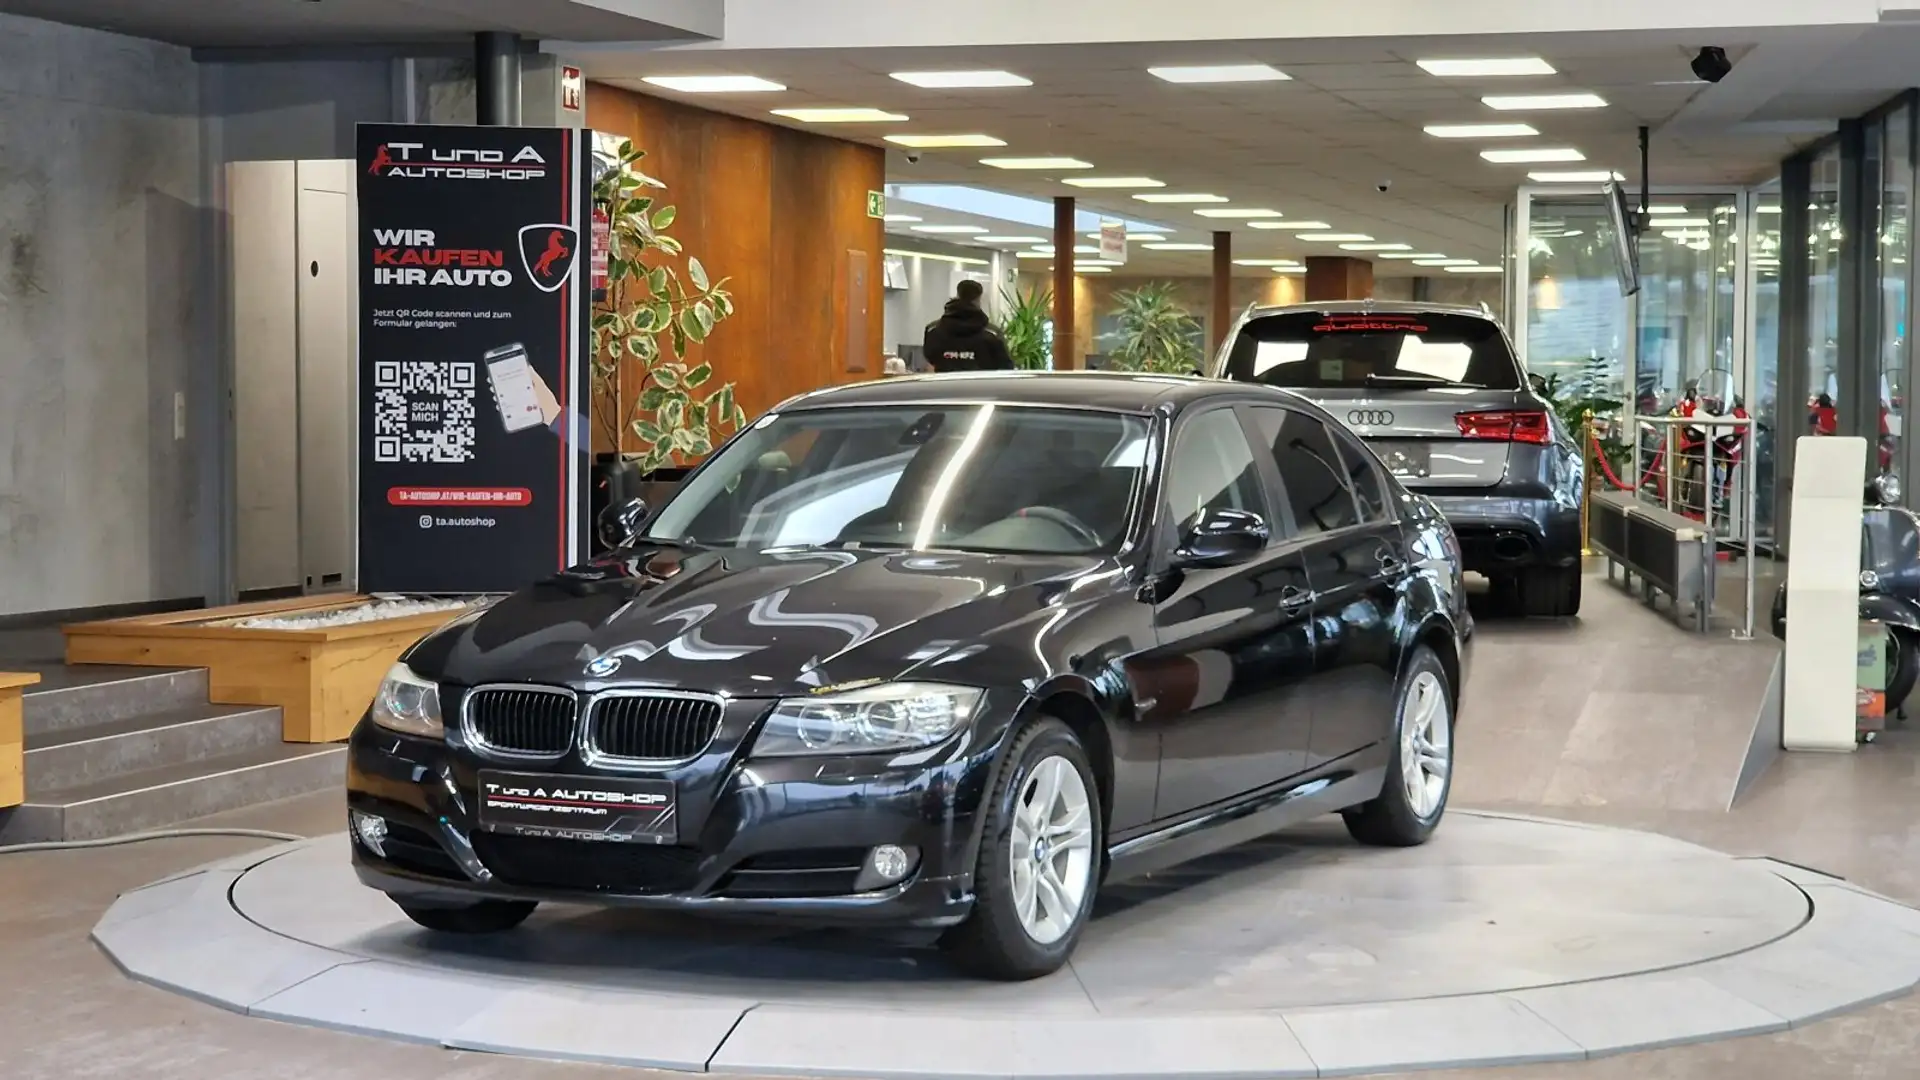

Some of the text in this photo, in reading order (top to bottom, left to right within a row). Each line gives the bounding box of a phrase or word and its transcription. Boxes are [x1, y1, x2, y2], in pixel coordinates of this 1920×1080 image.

[387, 142, 424, 161] T
[510, 145, 546, 164] A
[387, 166, 546, 180] AUTOSHOP
[373, 228, 435, 247] WIR
[373, 248, 503, 267] KAUFEN
[374, 268, 513, 287] IHR AUTO
[373, 309, 512, 319] Jetzt QR Code scannen und zum
[373, 319, 457, 329] Formular gelangen:
[1312, 322, 1428, 332] quattro
[411, 402, 440, 412] SCAN
[411, 412, 440, 422] MICH
[436, 516, 496, 528] ta.autoshop
[485, 783, 500, 794] T
[533, 788, 547, 798] A
[551, 788, 667, 804] AUTOSHOP
[515, 826, 525, 835] T
[542, 828, 552, 837] A
[555, 830, 633, 842] AUTOSHOP
